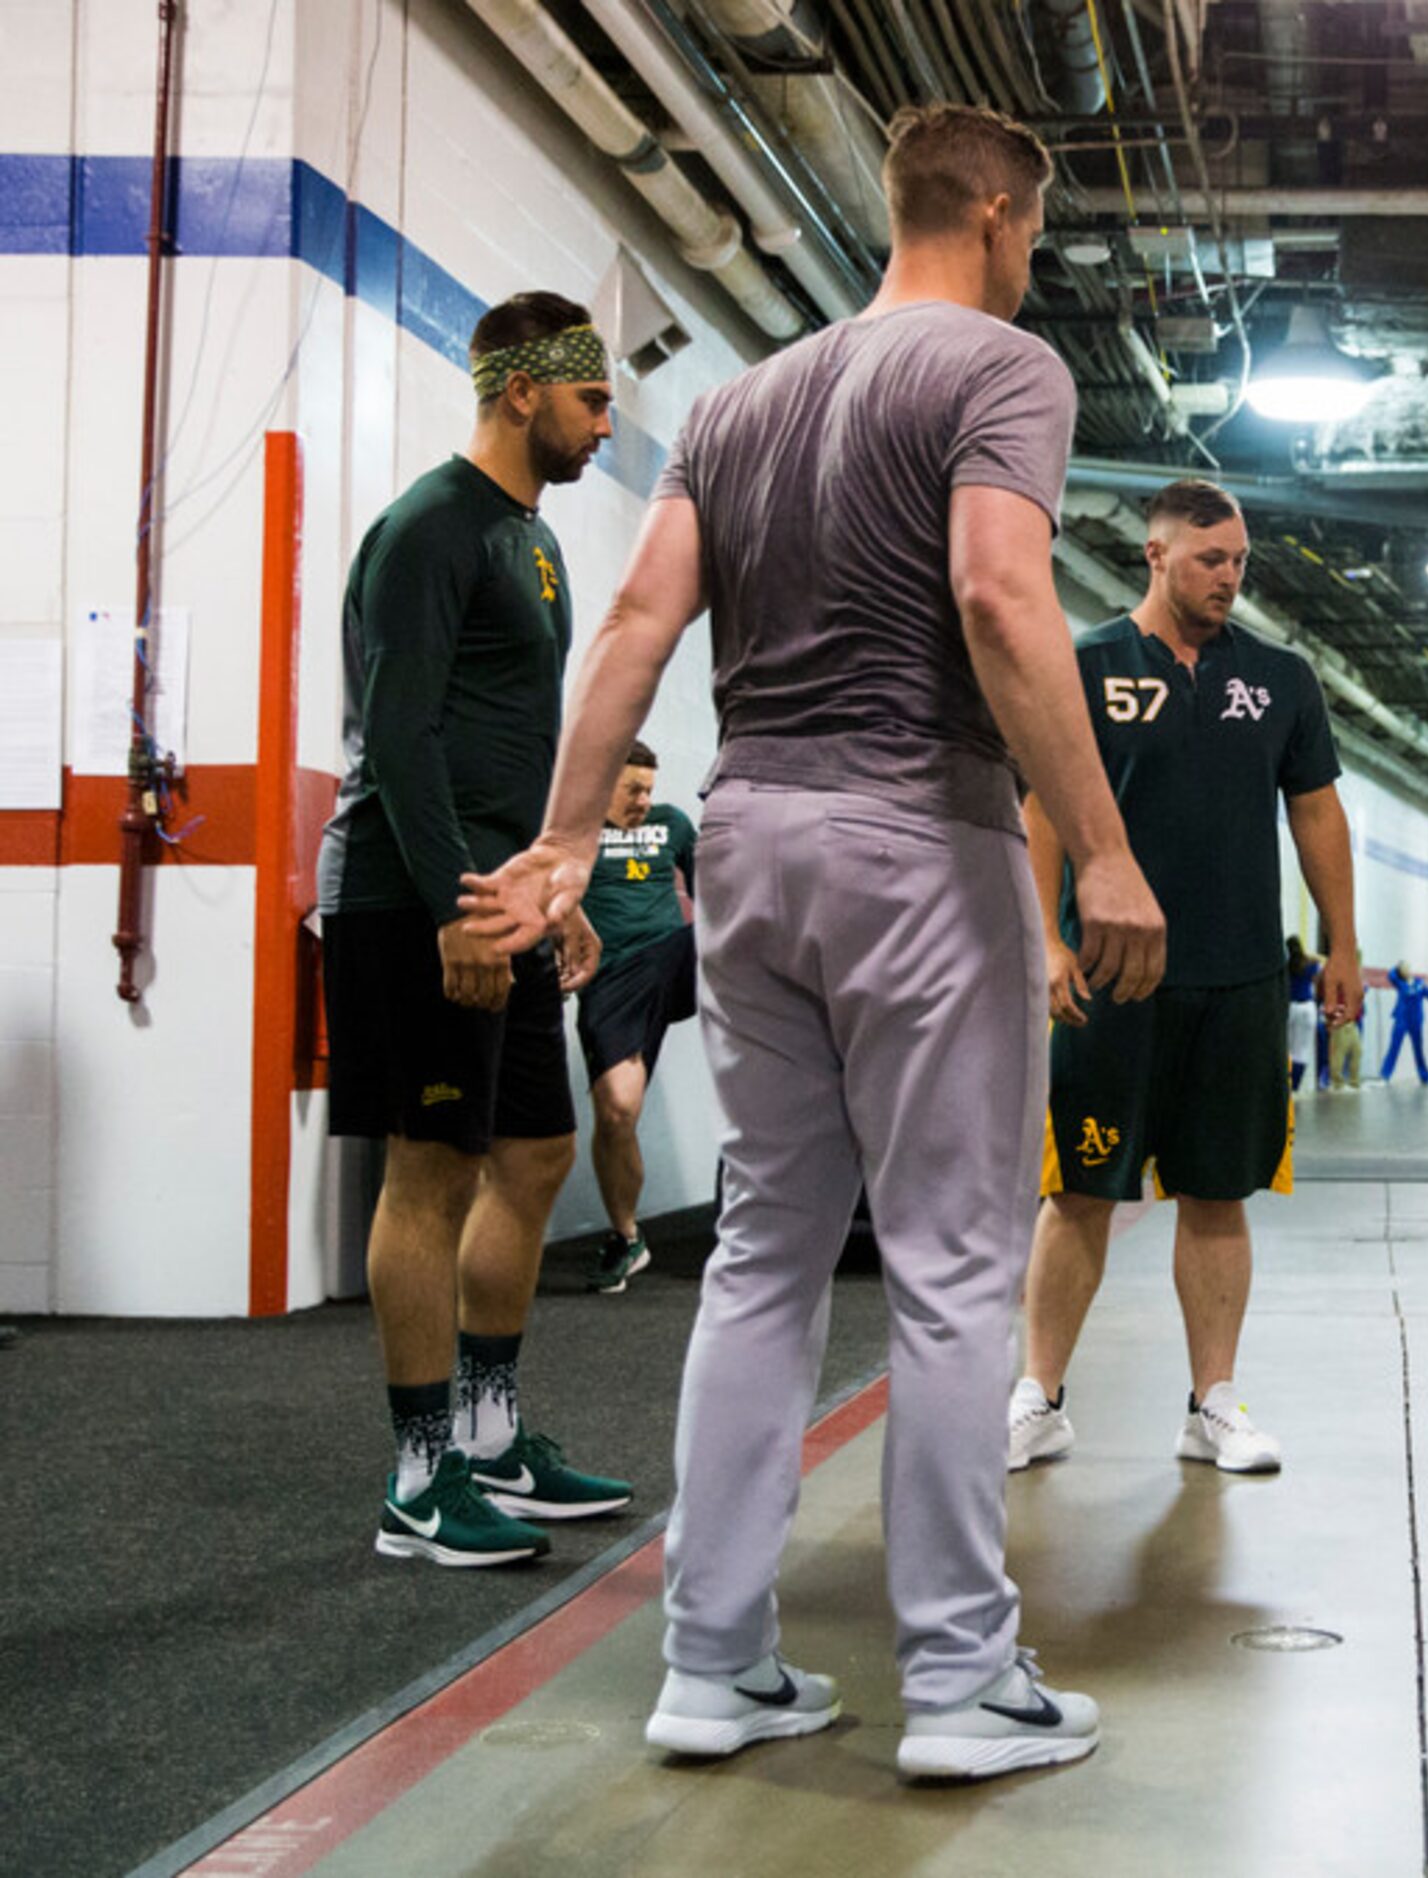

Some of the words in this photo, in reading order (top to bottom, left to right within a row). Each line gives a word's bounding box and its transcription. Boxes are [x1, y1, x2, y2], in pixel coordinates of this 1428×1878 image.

[1103, 677, 1170, 723] 57
[1219, 677, 1272, 721] A's
[1075, 1116, 1121, 1156] A's
